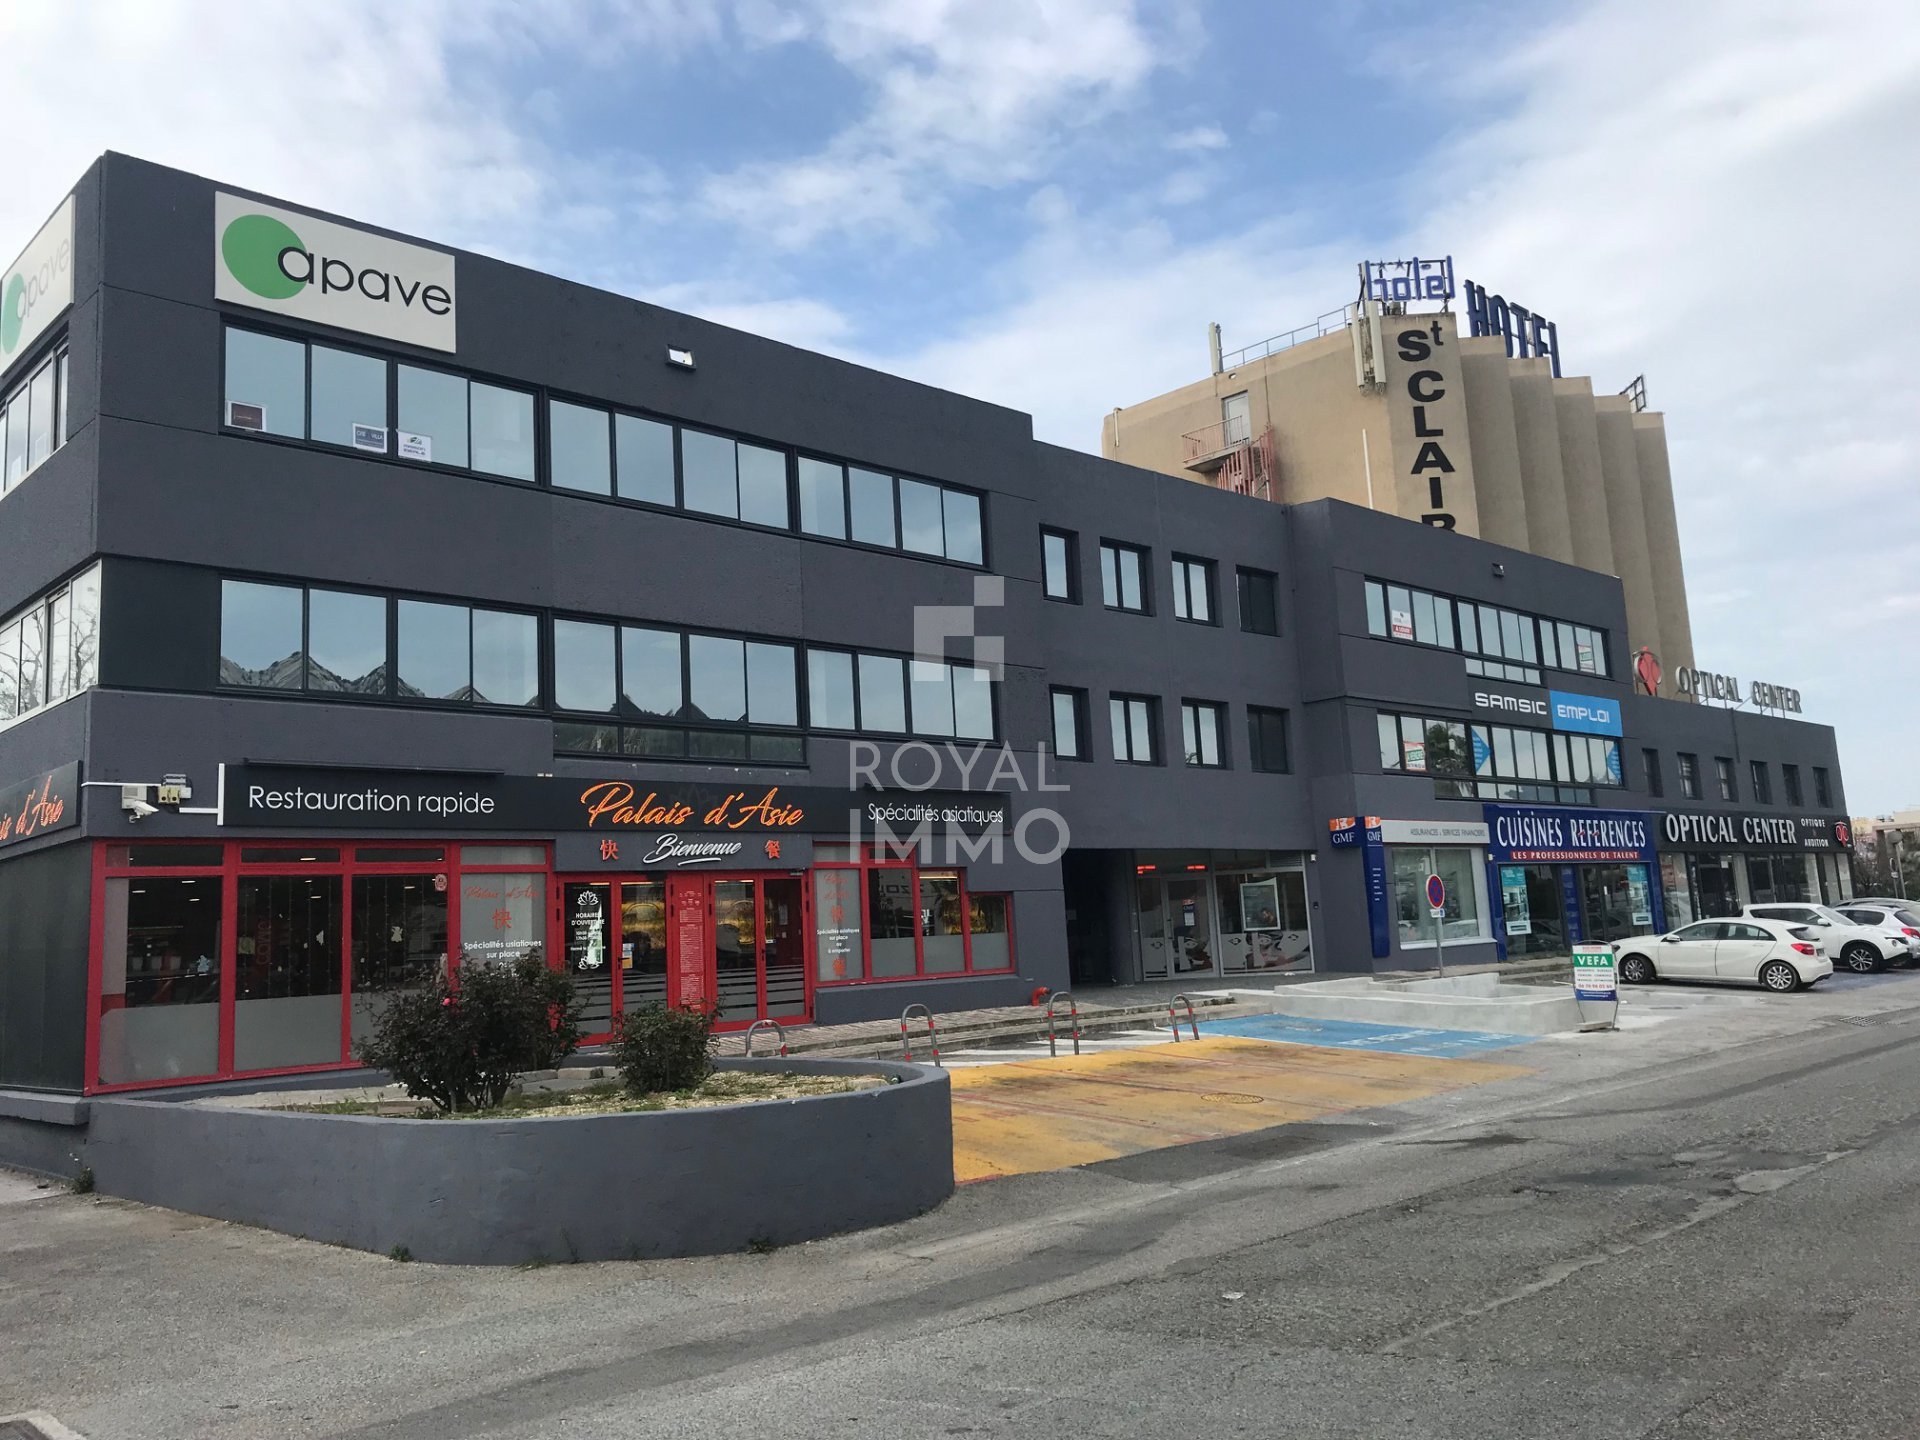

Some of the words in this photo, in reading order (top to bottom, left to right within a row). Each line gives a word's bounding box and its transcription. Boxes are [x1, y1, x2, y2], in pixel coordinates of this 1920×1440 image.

[17, 238, 70, 319] apave
[277, 245, 452, 316] apave
[1365, 255, 1455, 302] hotel
[1397, 320, 1444, 362] St
[1676, 665, 1743, 703] OPTICAL
[1751, 680, 1803, 713] CENTER
[1474, 692, 1547, 715] SAMSIC
[1557, 704, 1610, 723] EMPLOI
[249, 785, 411, 812] Restauration
[418, 791, 495, 817] rapide
[581, 782, 695, 828] Palais
[704, 786, 805, 829] d'Asie
[868, 802, 939, 825] Spécialités
[941, 805, 1004, 826] asiatiques
[1332, 832, 1355, 844] GMF
[1367, 831, 1383, 842] GMF
[1496, 810, 1563, 847] CUISINES
[1665, 813, 1738, 843] OPTICAL
[1742, 817, 1797, 844] CENTER
[1804, 838, 1829, 848] AUDITION
[643, 833, 742, 864] Bienvenue
[1512, 851, 1527, 859] LES
[1530, 852, 1597, 860] PROFESSIONNELS
[1612, 851, 1638, 859] TALENT
[464, 941, 504, 951] Spécialités
[505, 940, 542, 948] asiatiques
[499, 951, 520, 959] place
[1577, 955, 1609, 966] VEFA
